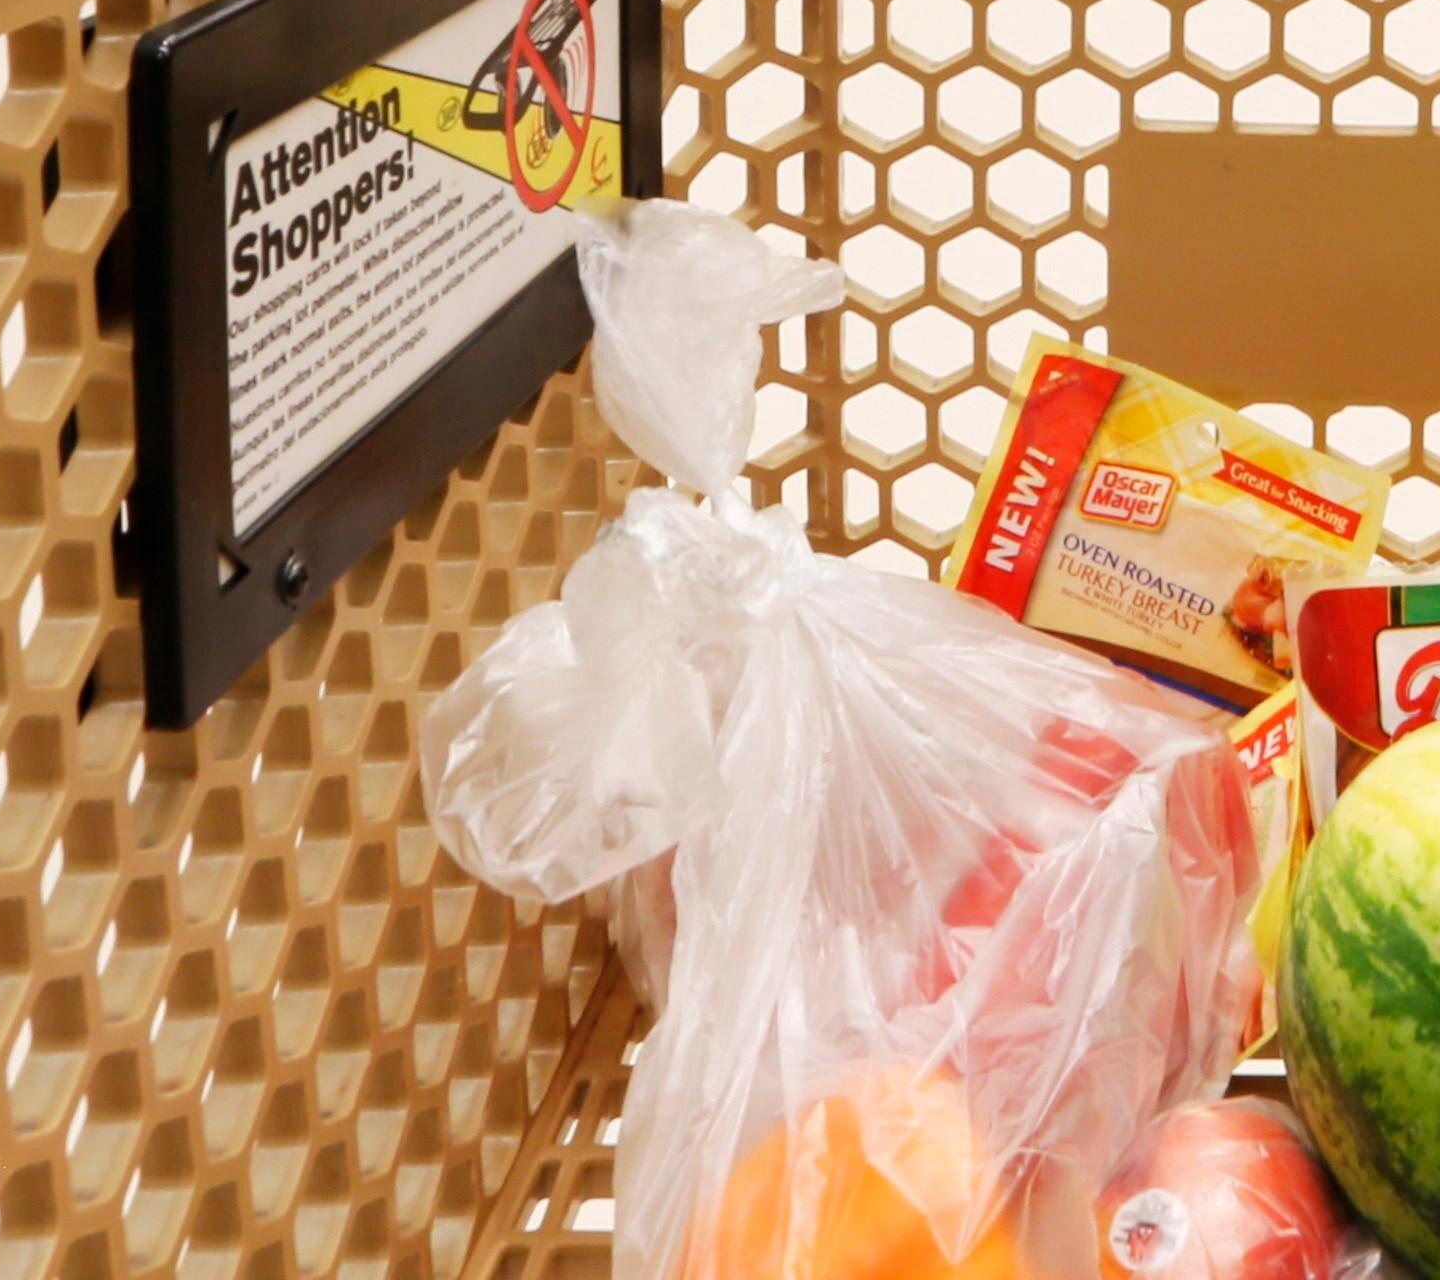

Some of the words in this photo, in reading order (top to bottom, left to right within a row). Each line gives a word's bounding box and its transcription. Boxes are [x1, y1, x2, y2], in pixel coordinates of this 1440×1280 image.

[229, 87, 400, 229] Attention
[230, 130, 414, 298] Shoppers!
[253, 280, 302, 322] shopping
[984, 445, 1056, 573] NEW!
[1091, 488, 1160, 517] Mayer
[1103, 470, 1164, 497] Oscar
[1230, 462, 1271, 494] Great
[1285, 488, 1350, 534] Snacking
[1056, 553, 1132, 599] TURKEY
[1131, 589, 1205, 636] BREAST
[1062, 533, 1121, 570] OVEN
[1123, 560, 1215, 617] ROASTED
